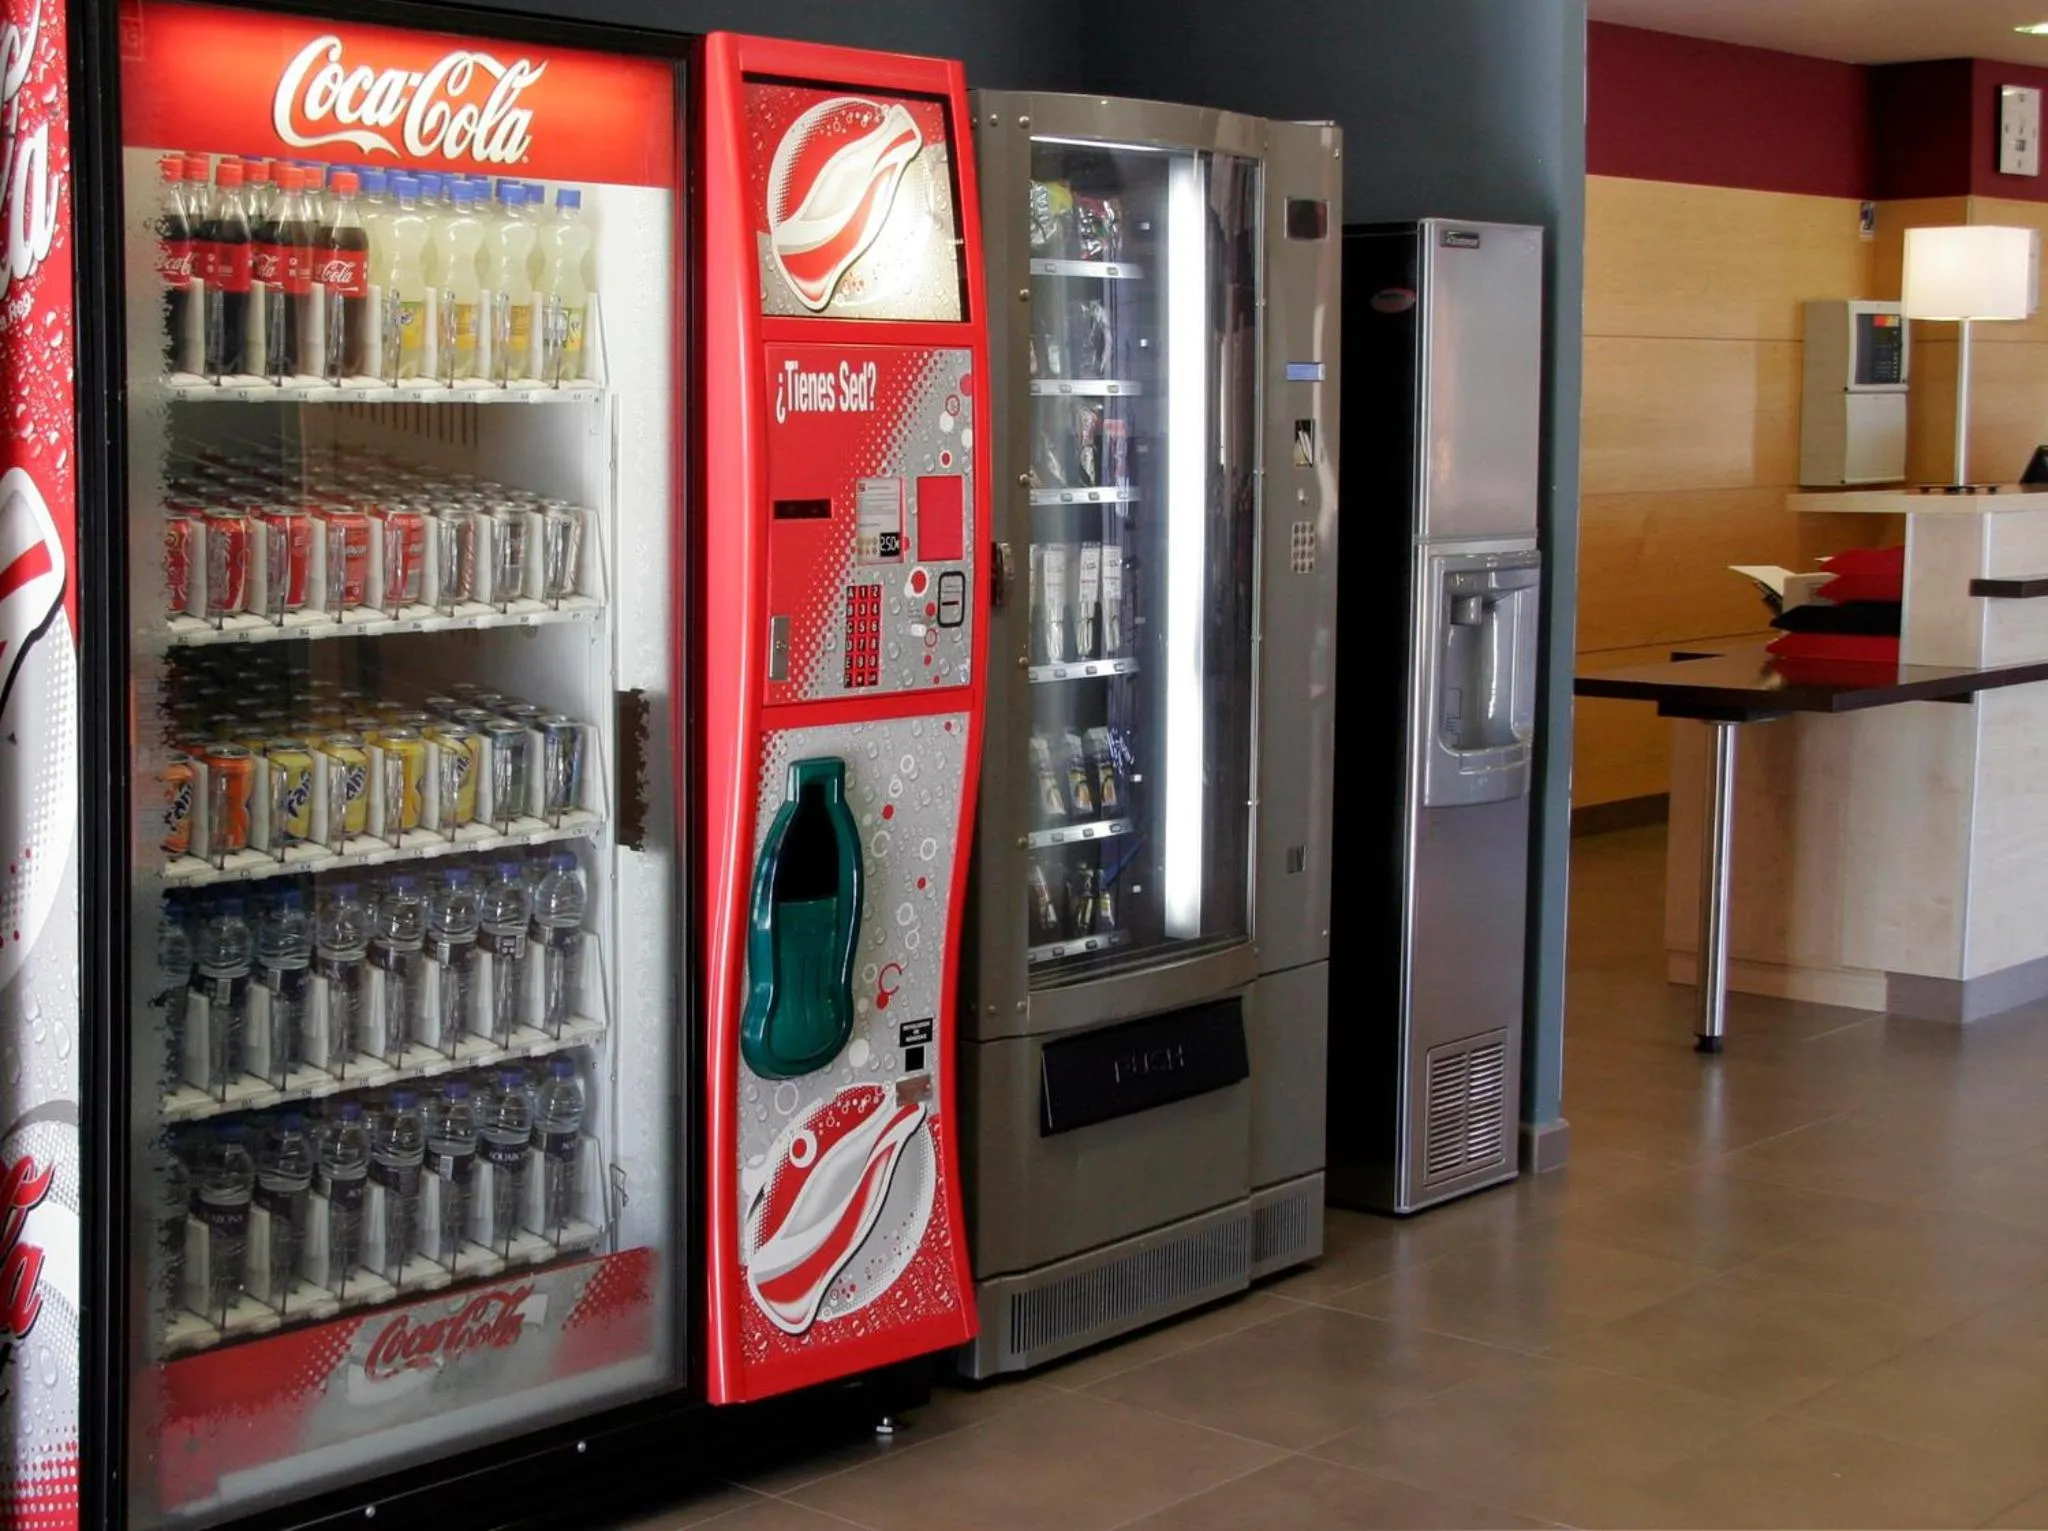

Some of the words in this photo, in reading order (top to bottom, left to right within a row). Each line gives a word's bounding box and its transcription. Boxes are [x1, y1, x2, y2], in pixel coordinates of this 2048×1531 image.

[273, 35, 547, 165] Coca-Cola
[776, 360, 836, 424] ¿Tienes
[839, 360, 876, 412] Sed?
[1114, 1043, 1184, 1083] PUSH
